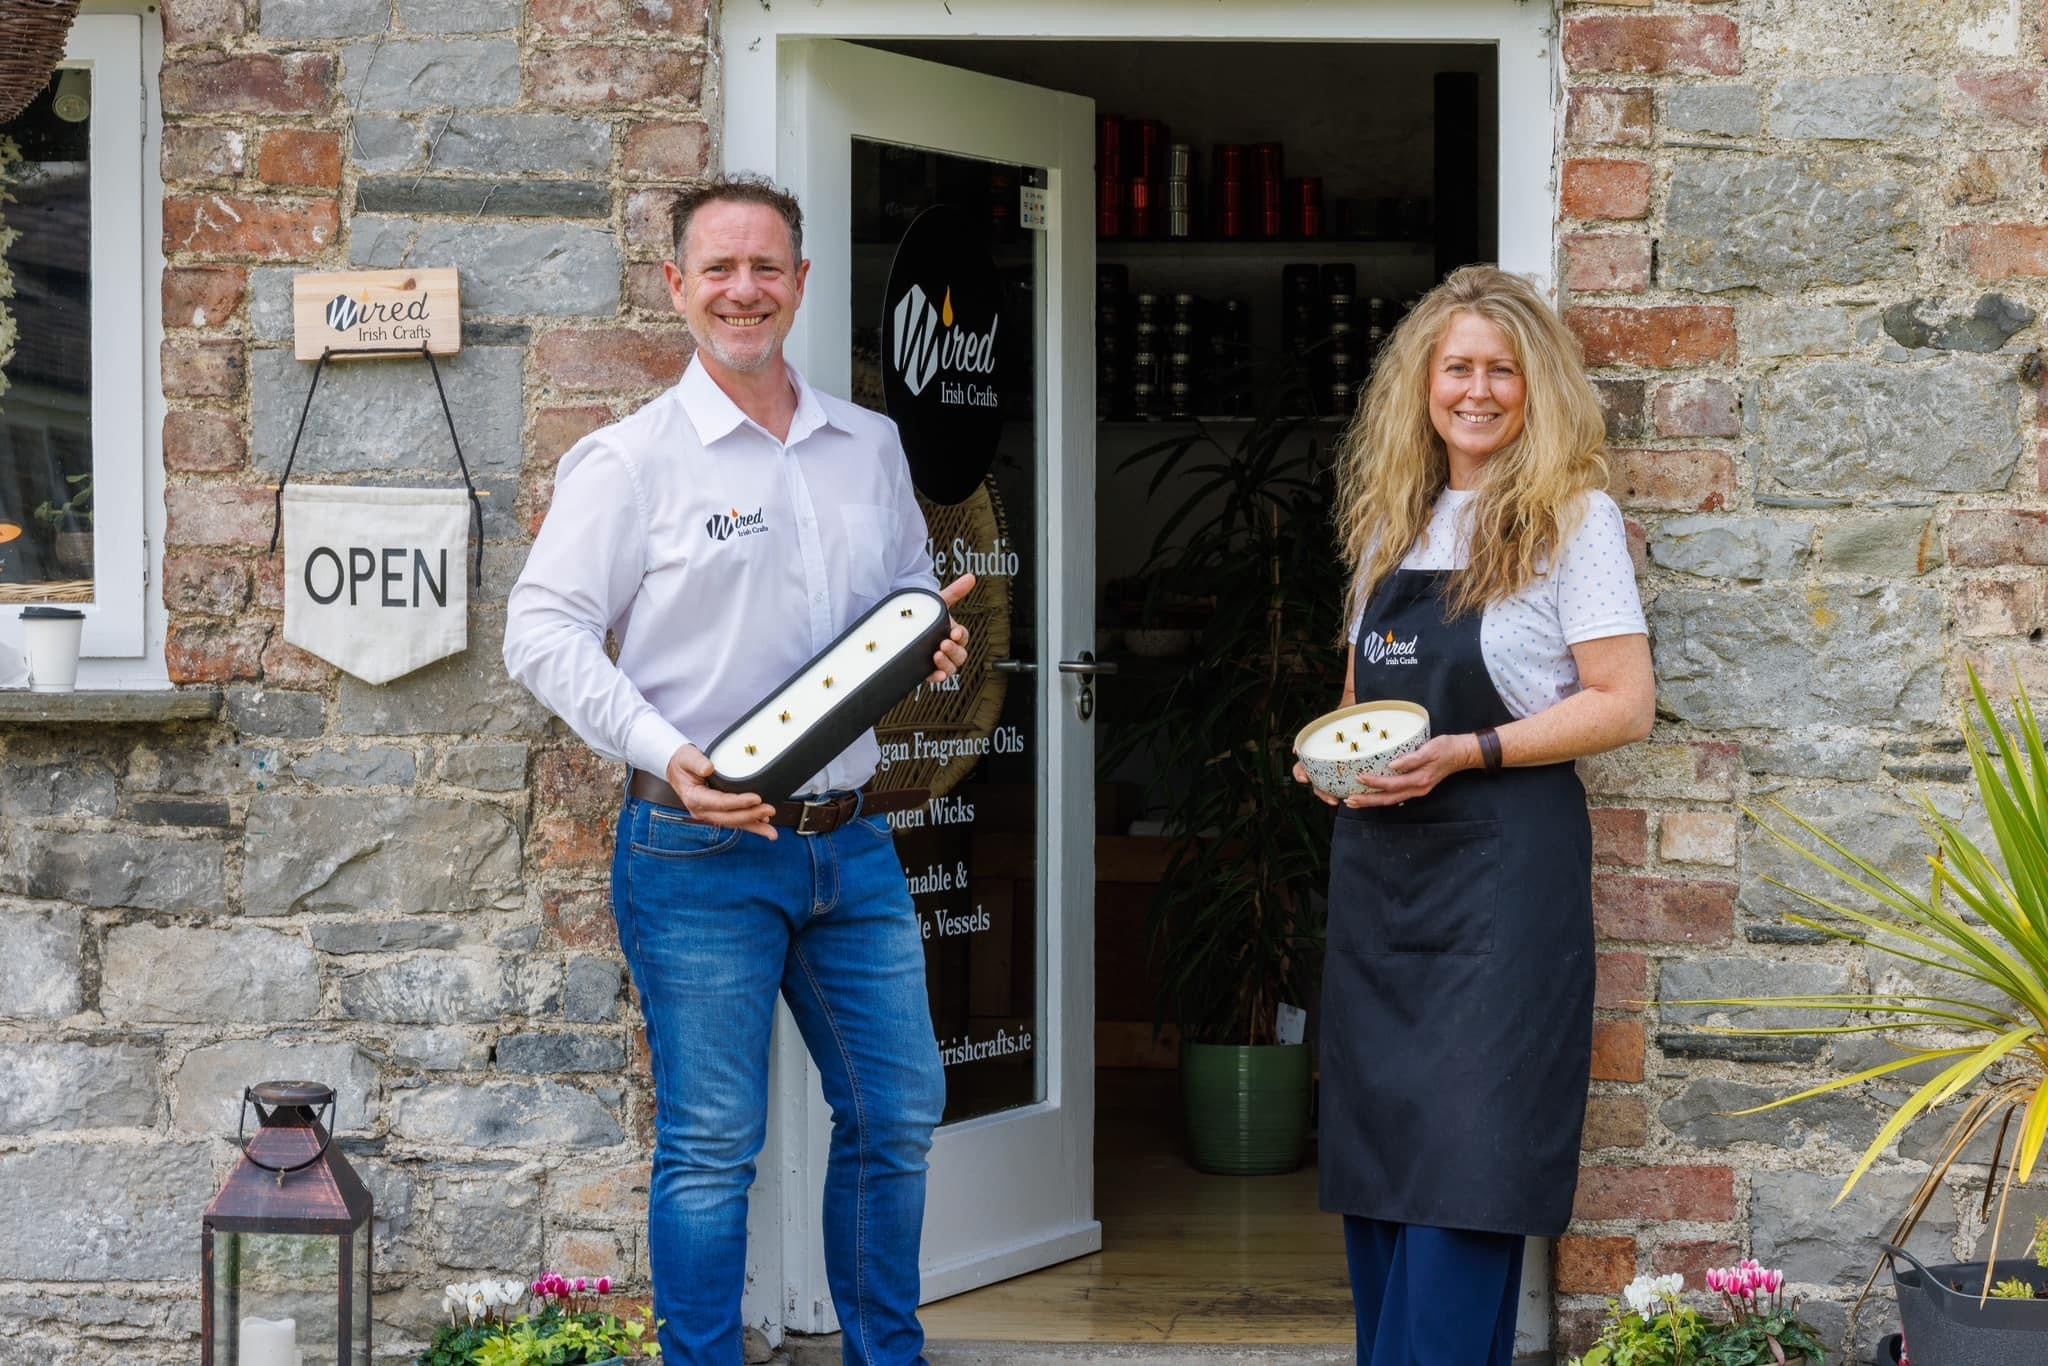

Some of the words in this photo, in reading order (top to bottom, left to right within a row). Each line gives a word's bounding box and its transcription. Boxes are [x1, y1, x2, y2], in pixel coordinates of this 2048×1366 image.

[326, 289, 430, 331] Wired
[358, 327, 388, 341] Irish
[393, 324, 431, 340] Crafts
[894, 284, 999, 396] Wired
[941, 381, 965, 405] Irish
[967, 384, 999, 407] Crafts
[706, 507, 763, 541] Wired
[953, 537, 1019, 576] Studio
[304, 546, 447, 608] OPEN
[1364, 630, 1418, 664] Wired
[1385, 657, 1399, 665] Irish
[1400, 656, 1418, 665] Crafts
[881, 742, 910, 771] gan
[913, 731, 990, 767] Fragrance
[994, 726, 1024, 754] Oils
[886, 809, 925, 829] oden
[928, 795, 975, 826] Wicks
[955, 861, 968, 889] &
[935, 904, 990, 937] Vessels
[936, 1025, 1032, 1067] irishcrafts.ie
